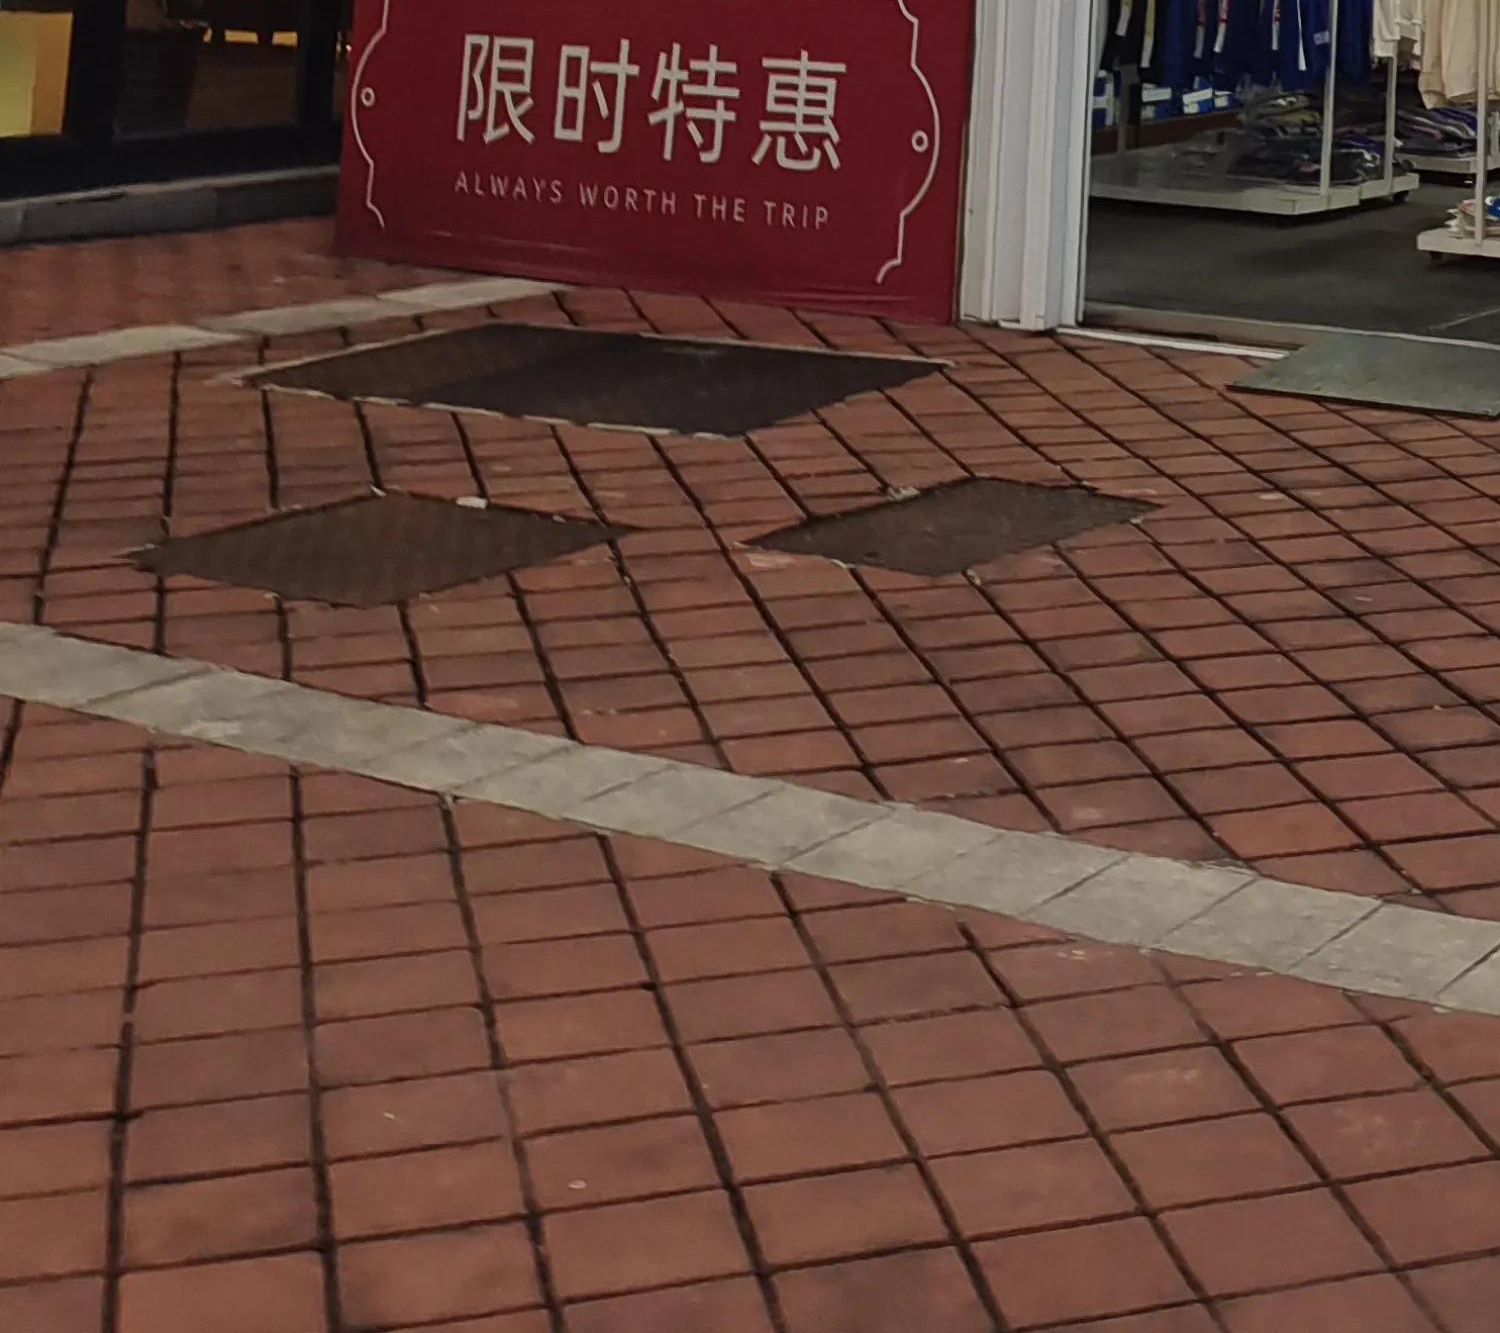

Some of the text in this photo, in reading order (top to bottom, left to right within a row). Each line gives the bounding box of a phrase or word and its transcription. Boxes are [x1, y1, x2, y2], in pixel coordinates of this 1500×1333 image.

[456, 33, 847, 171] 限时特惠
[453, 171, 831, 230] ALWAYS WORTH THE TRIP
